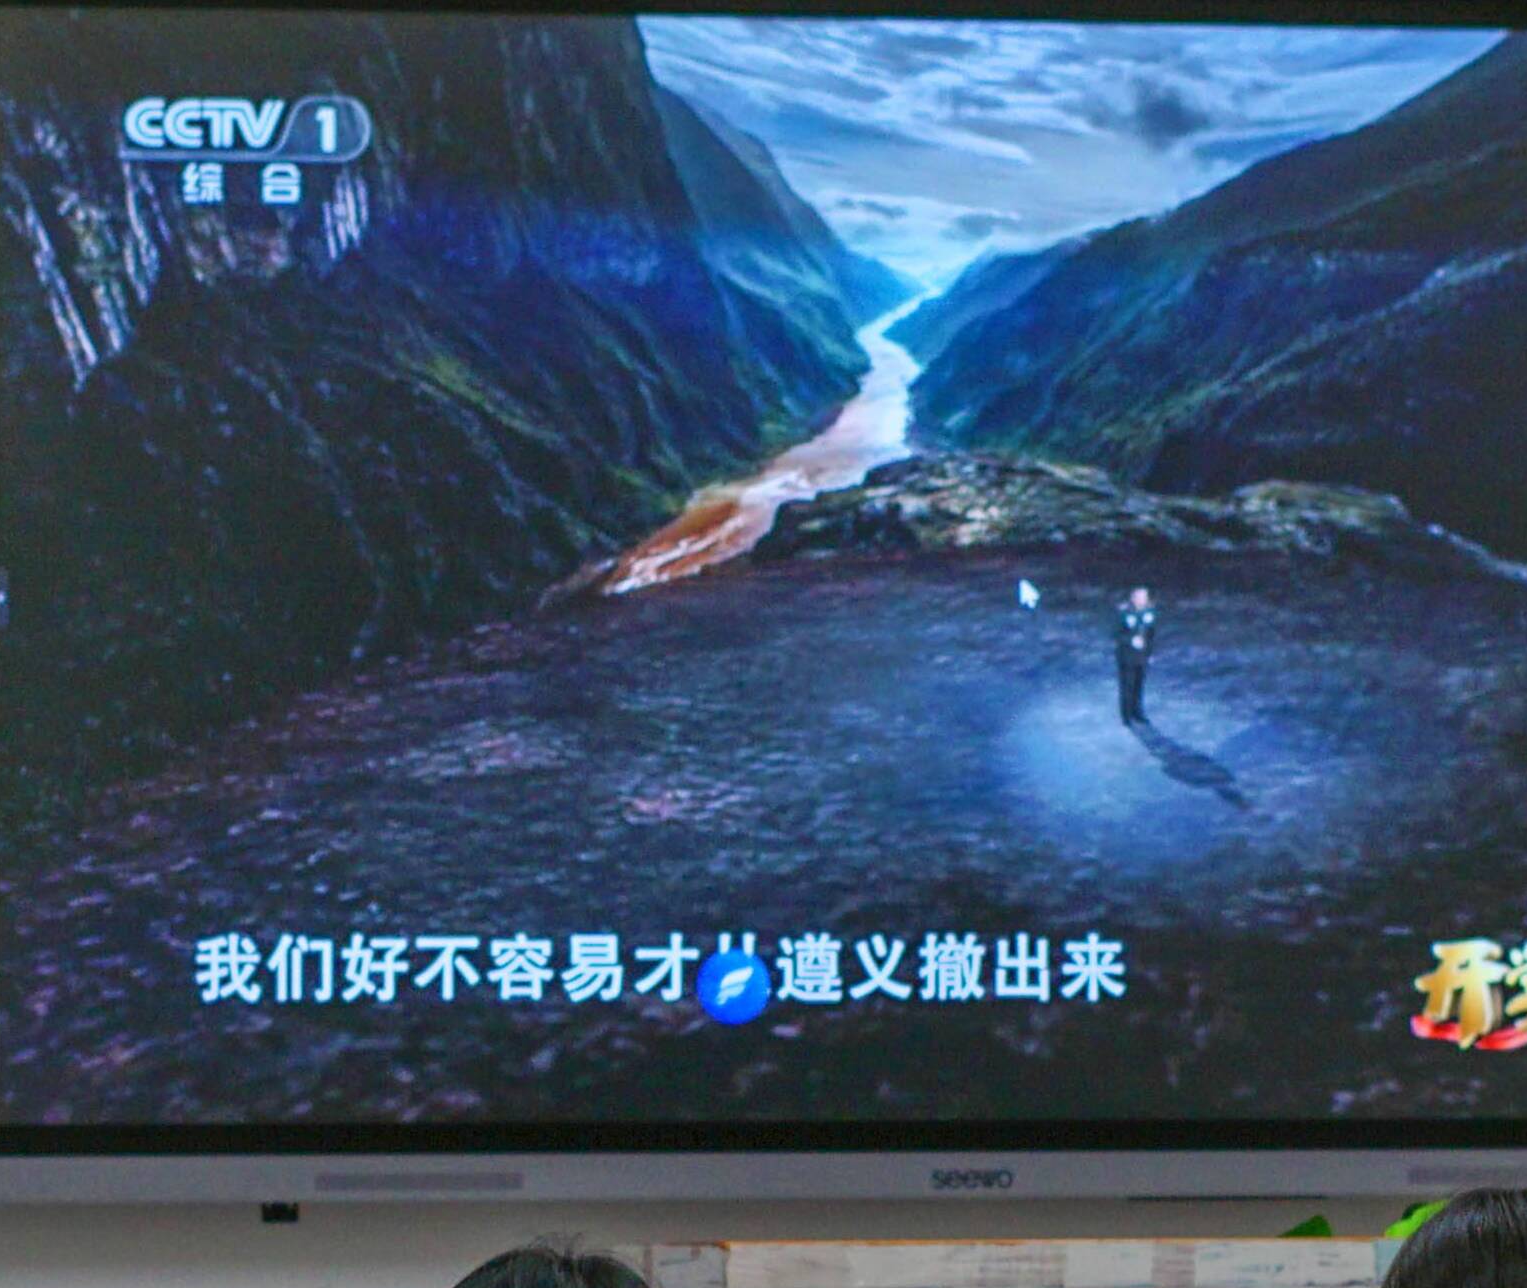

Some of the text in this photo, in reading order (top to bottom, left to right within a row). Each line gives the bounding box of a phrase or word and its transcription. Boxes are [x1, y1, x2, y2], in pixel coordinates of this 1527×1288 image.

[125, 99, 337, 153] CCTV 1
[195, 933, 1126, 1002] 我们好不容易才遵义撤出来
